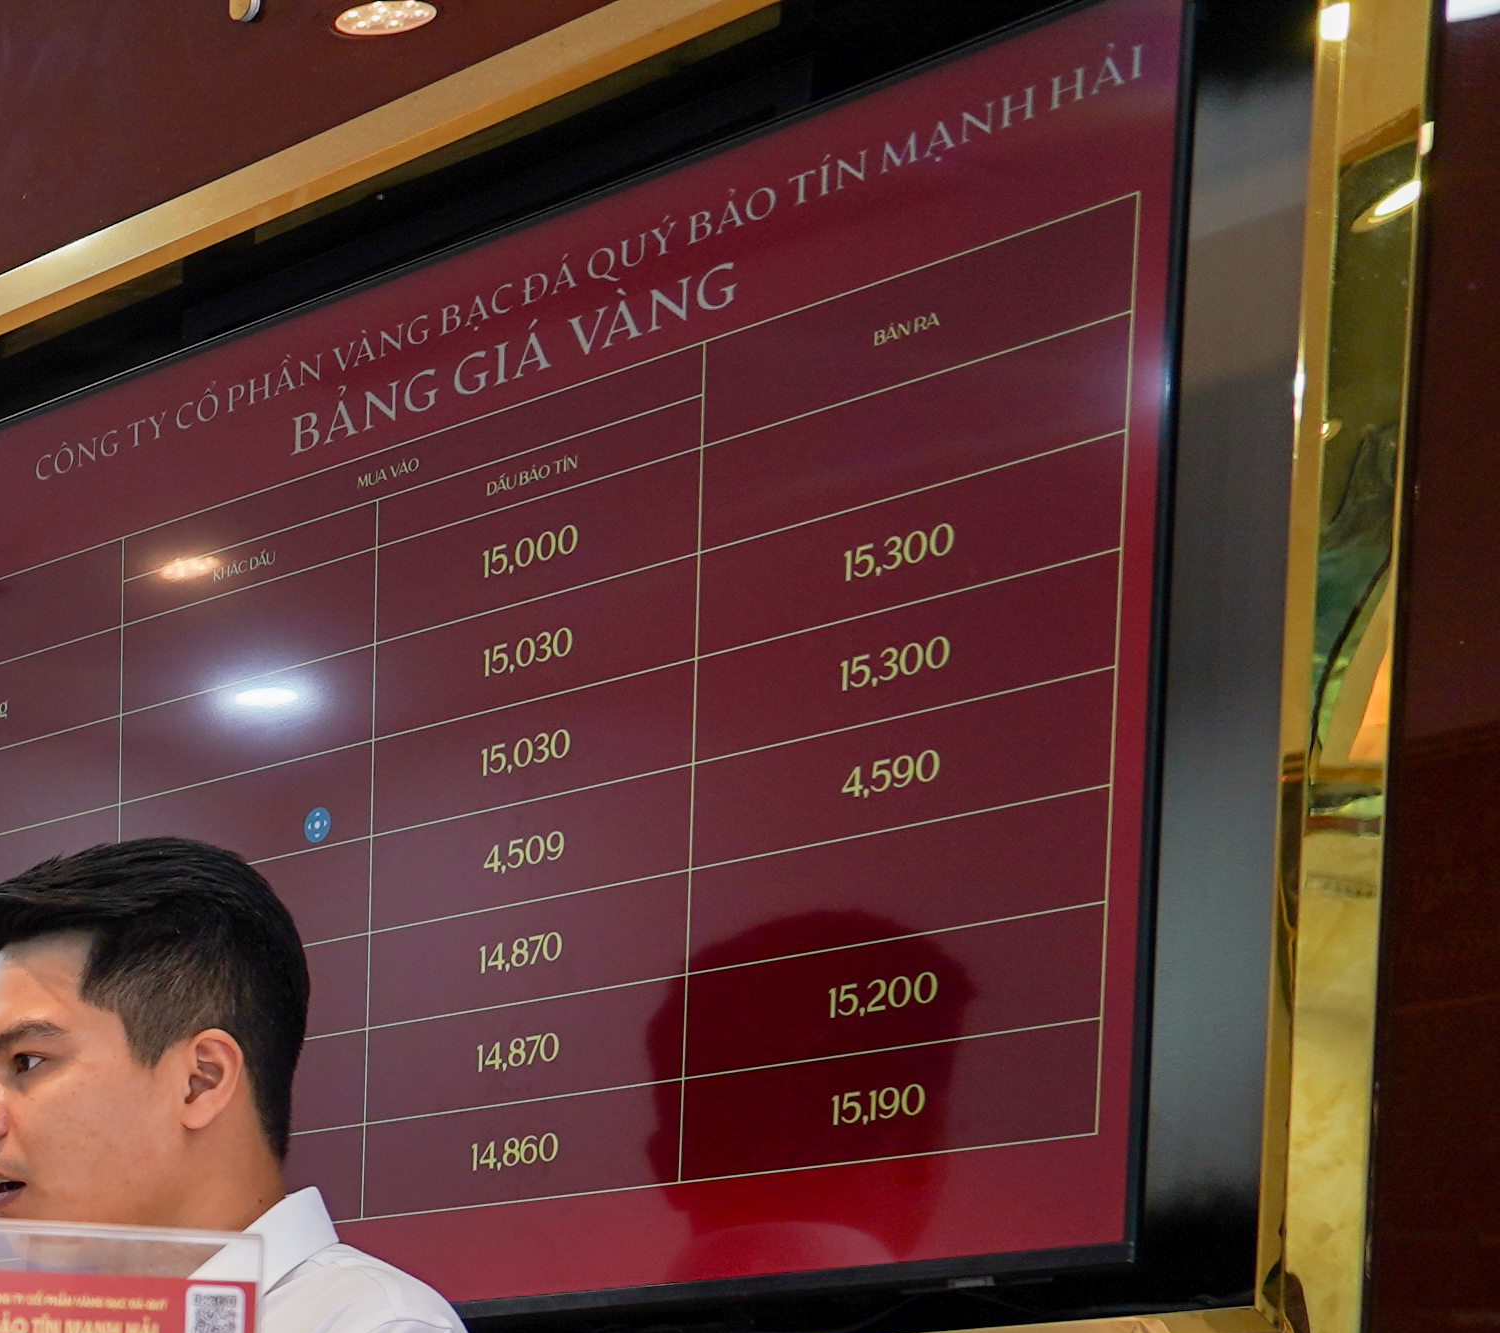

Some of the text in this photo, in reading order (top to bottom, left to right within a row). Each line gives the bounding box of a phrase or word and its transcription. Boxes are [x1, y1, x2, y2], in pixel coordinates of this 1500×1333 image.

[34, 42, 1145, 482] CÔNG TY CỔ PHẦN VÀNG BẠC ĐÁ QUÝ BẢO TÍN MẠNH HẢI
[872, 311, 941, 347] BÁN RA
[289, 260, 740, 456] BẢNG GIÁ VÀNG
[356, 456, 420, 489] MUA VÀO
[485, 473, 518, 497] DẤU
[552, 454, 579, 481] TÍN
[210, 549, 277, 583] KHÁC DẤU
[480, 524, 580, 579] 15,000
[841, 522, 956, 583] 15,300
[481, 627, 574, 678] 15,030
[838, 634, 952, 693] 15,300
[479, 727, 572, 777] 15,030
[840, 748, 942, 801] 4,590
[482, 830, 567, 875] 4,509
[477, 931, 564, 975] 14,870
[827, 970, 940, 1019] 15,200
[475, 1032, 561, 1074] 14,870
[830, 1082, 927, 1127] 15,190
[469, 1131, 560, 1173] 14,860
